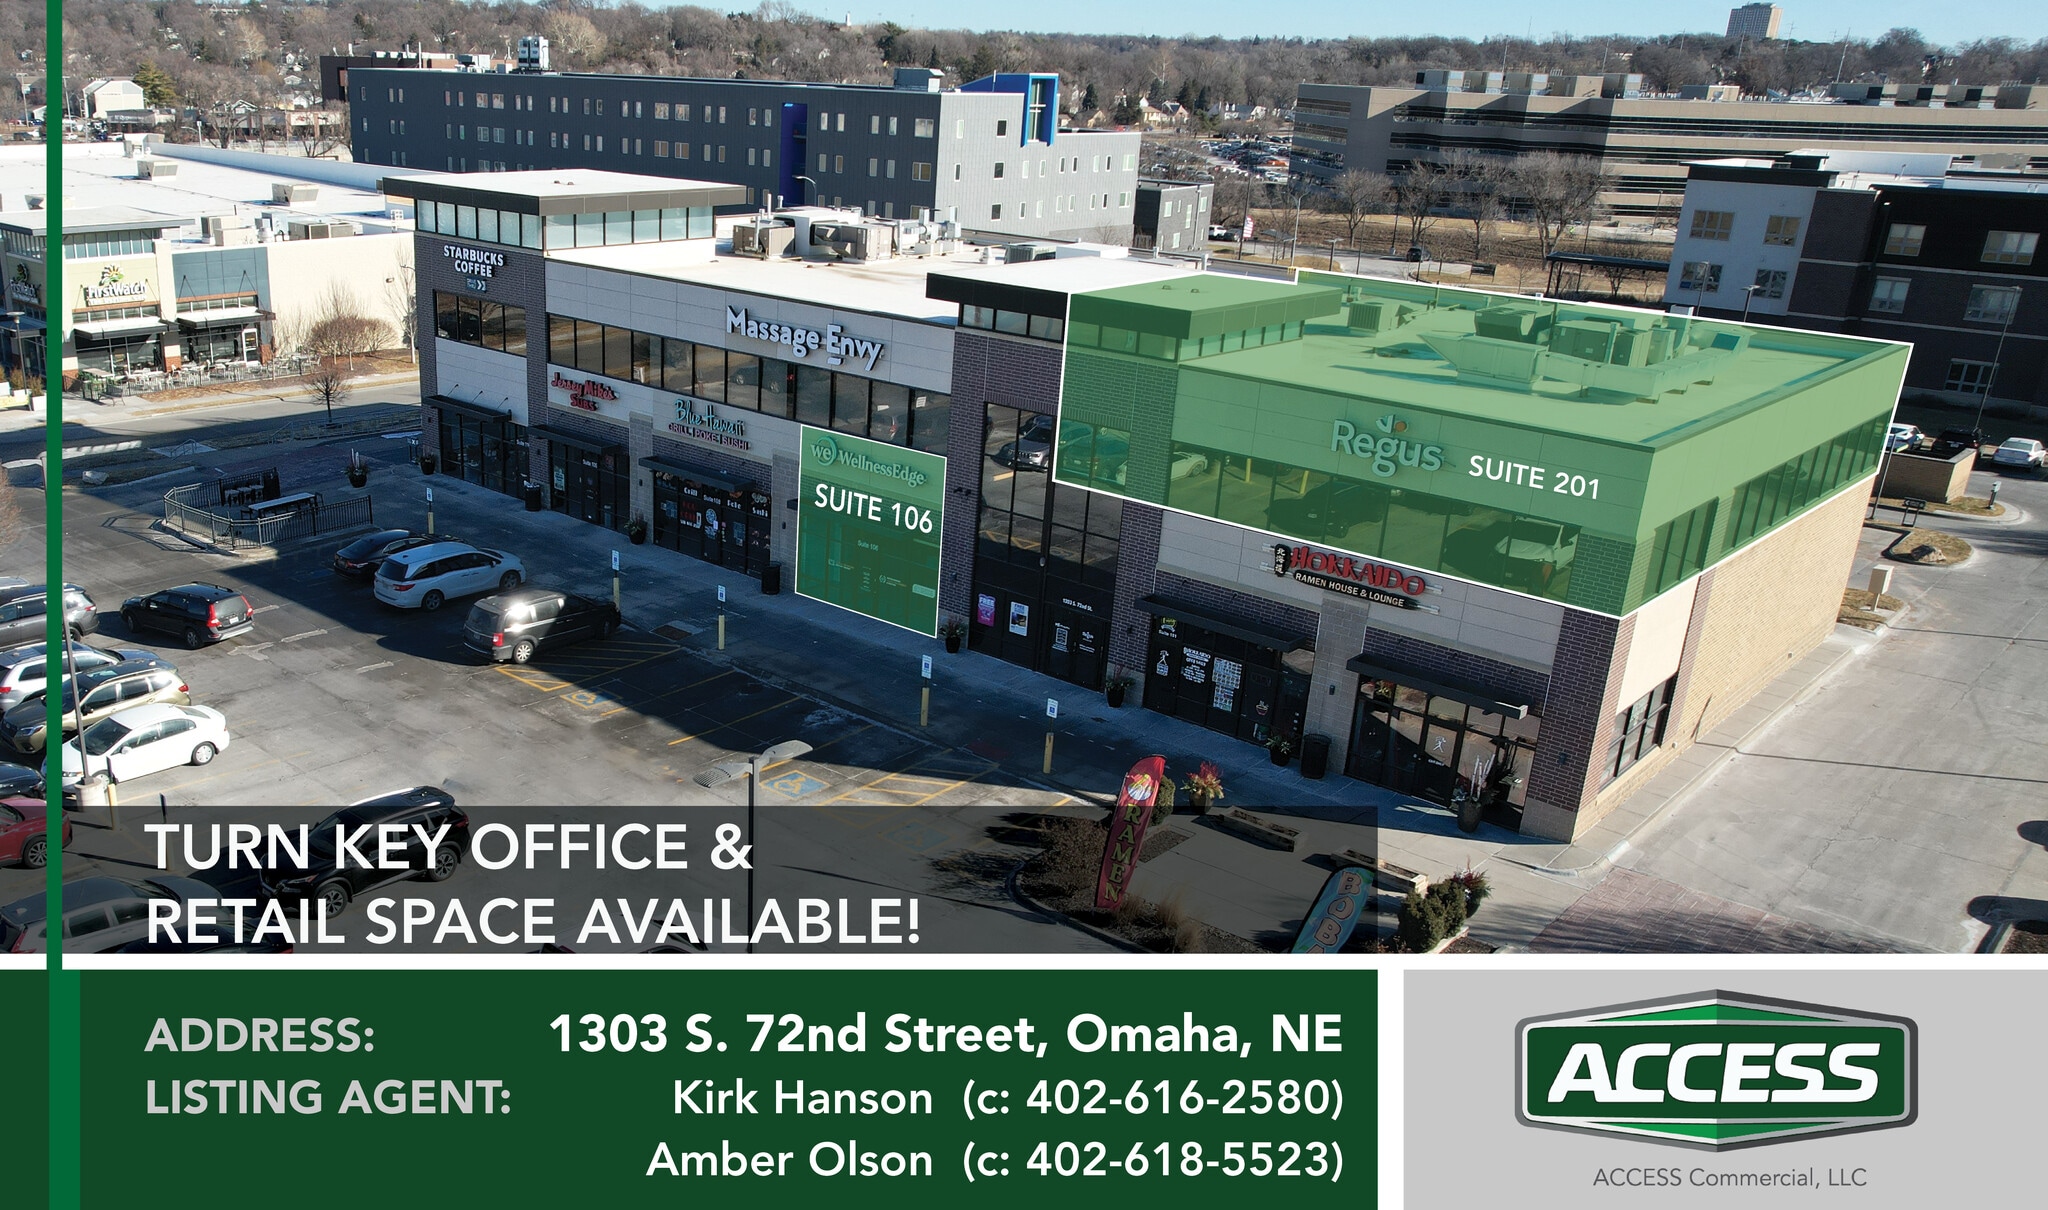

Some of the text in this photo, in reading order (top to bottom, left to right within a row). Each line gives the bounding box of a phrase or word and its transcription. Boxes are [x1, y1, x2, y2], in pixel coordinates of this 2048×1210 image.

[443, 245, 504, 266] STARBUCKS
[454, 260, 492, 277] COFFEE
[726, 305, 884, 372] Massage Envy
[551, 372, 617, 401] Jersey Mike's
[674, 398, 745, 436] Blue Hawaii
[668, 423, 749, 450] GRILL POKE SUSHI
[1330, 419, 1444, 478] Regus
[839, 449, 927, 488] WellnessEdge
[1291, 546, 1426, 596] HOKKAIDO
[1295, 573, 1405, 607] RAMEN HOUSE & LOUNGE
[1104, 803, 1142, 902] RAMEN
